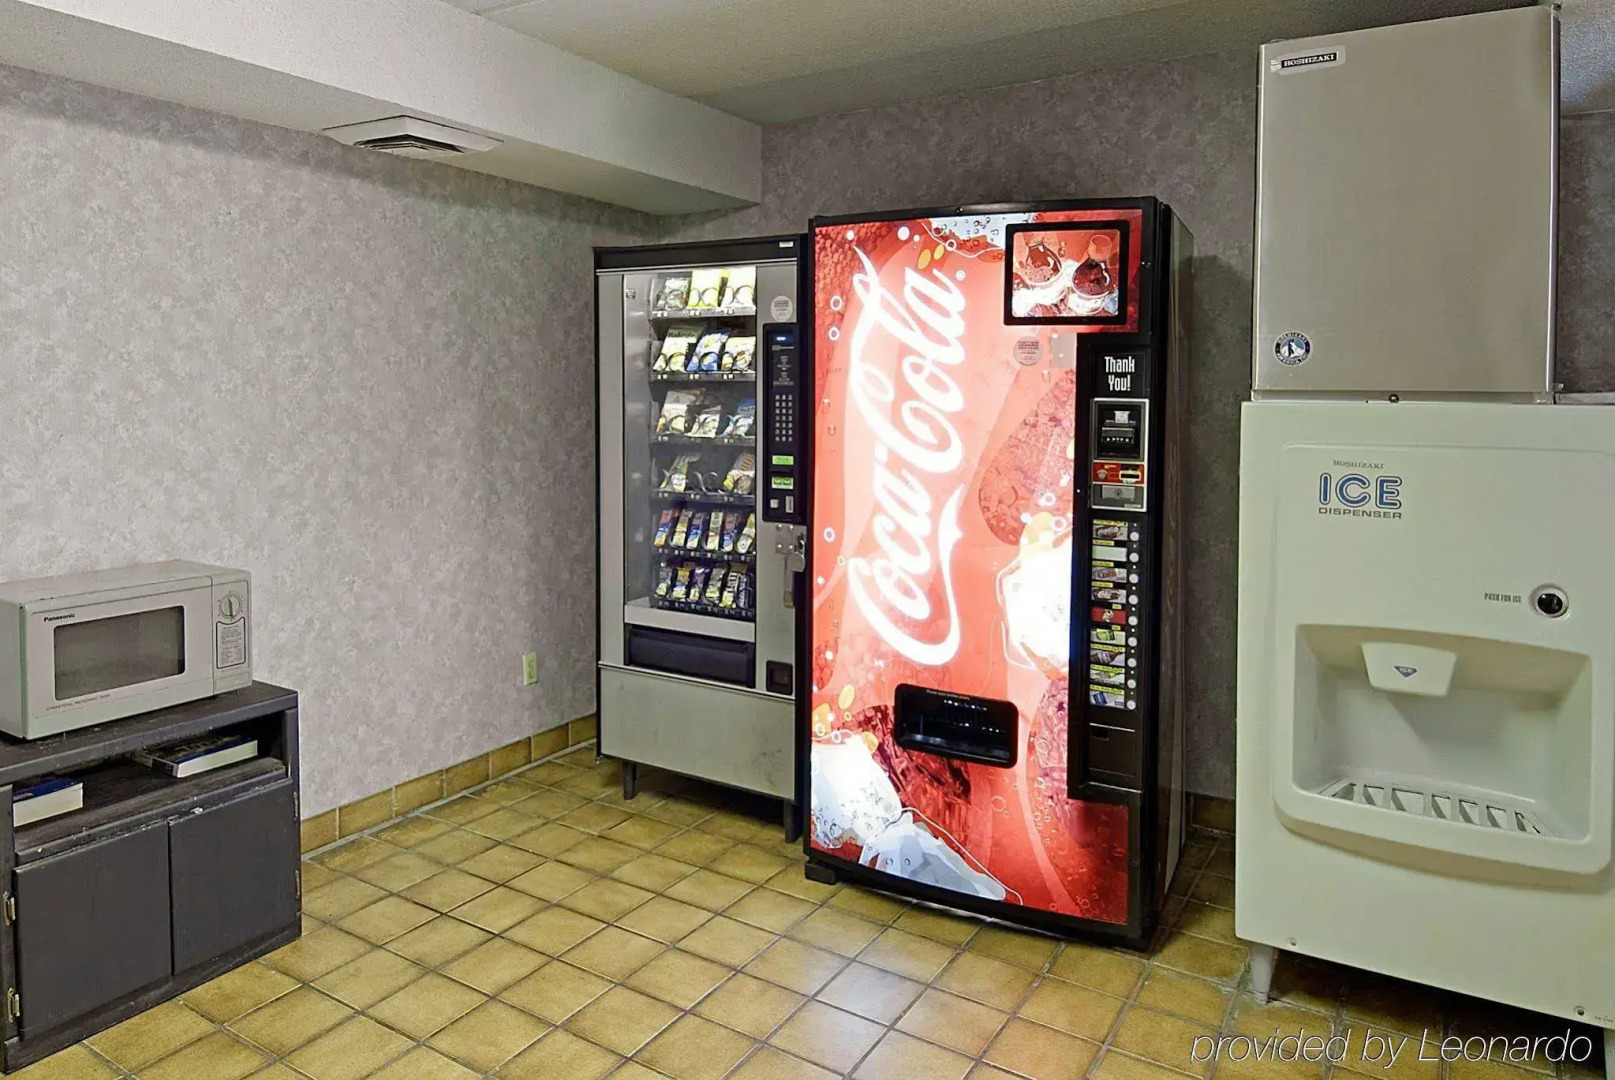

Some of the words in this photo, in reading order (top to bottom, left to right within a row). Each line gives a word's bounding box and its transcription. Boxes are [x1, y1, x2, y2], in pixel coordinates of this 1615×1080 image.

[1283, 54, 1335, 67] HOSHIZAKI
[1104, 356, 1135, 373] Thank
[1108, 375, 1131, 391] You!
[848, 244, 966, 665] Coca-Cola
[1333, 459, 1385, 469] HOSHIZAKI
[1319, 472, 1402, 510] ICE
[1318, 507, 1402, 519] DISPENSER
[44, 613, 75, 622] Panasonic
